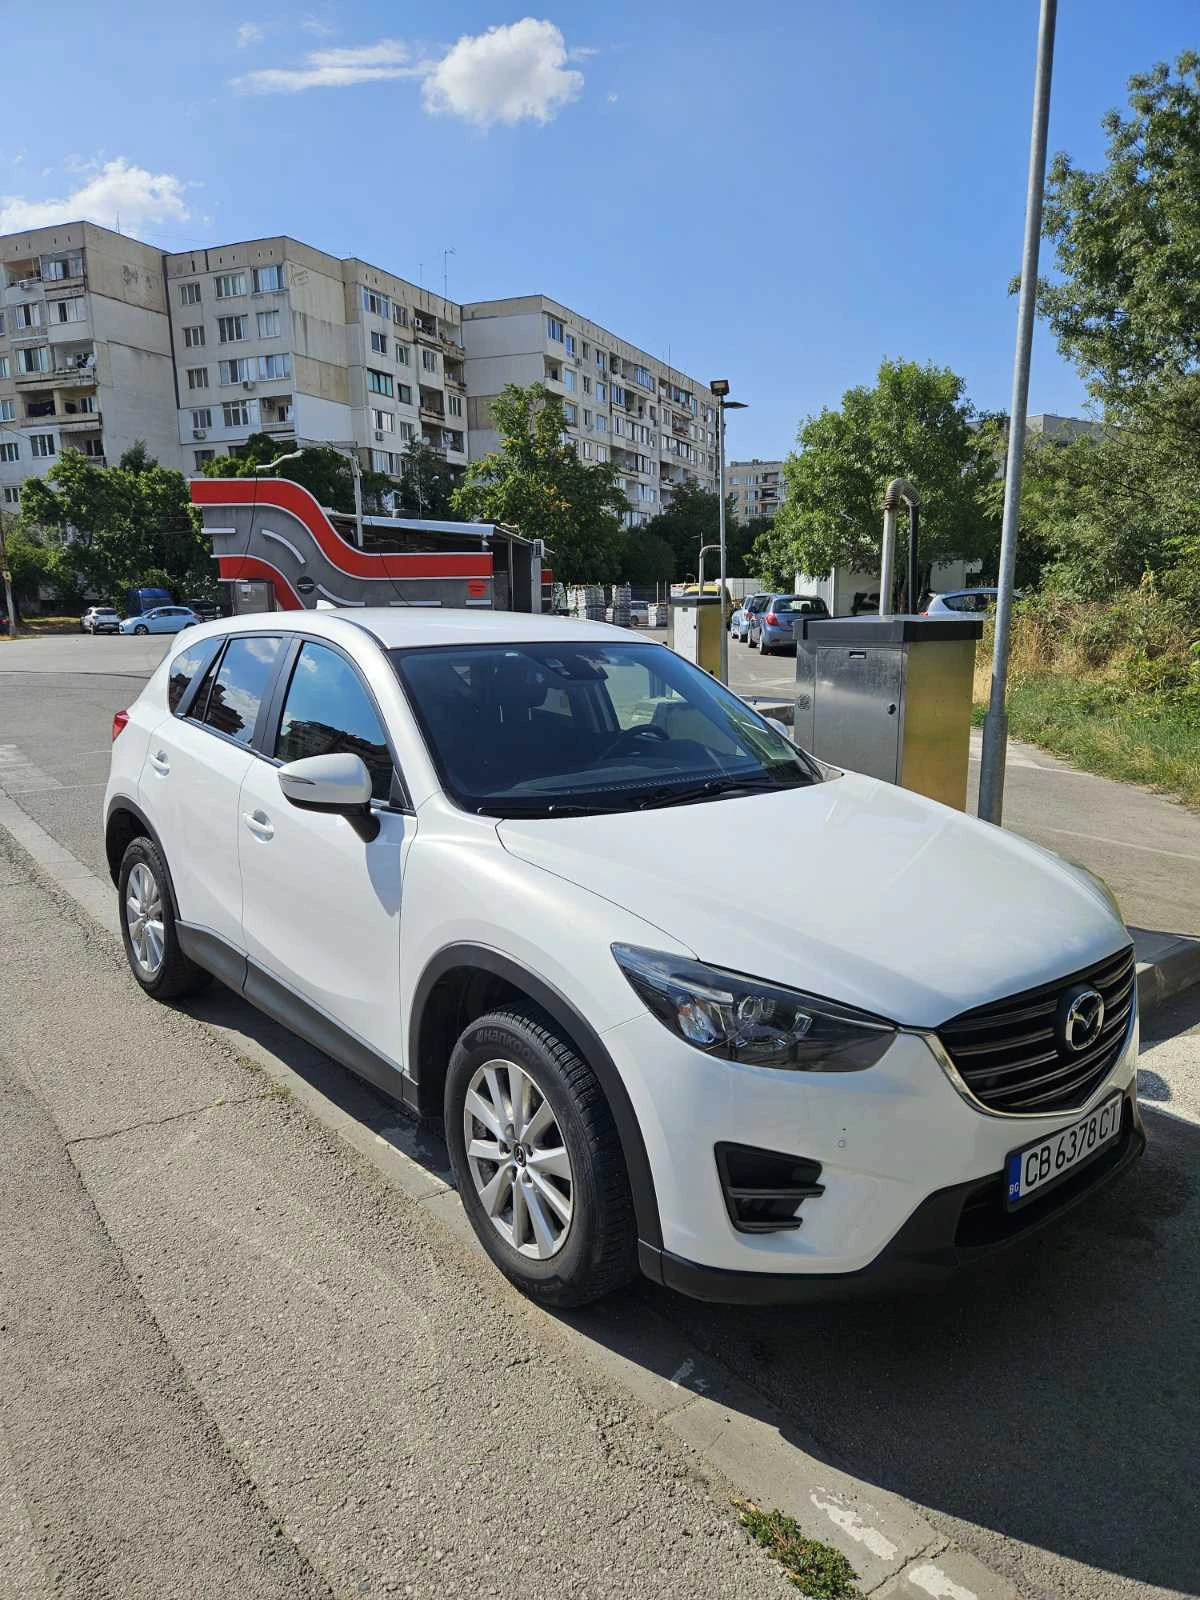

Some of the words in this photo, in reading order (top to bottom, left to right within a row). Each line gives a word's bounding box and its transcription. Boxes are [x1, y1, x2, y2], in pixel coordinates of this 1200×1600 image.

[1025, 1145, 1051, 1187] CB
[1055, 1117, 1097, 1170] 6378
[1099, 1100, 1119, 1139] CT
[1009, 1182, 1019, 1195] BG
